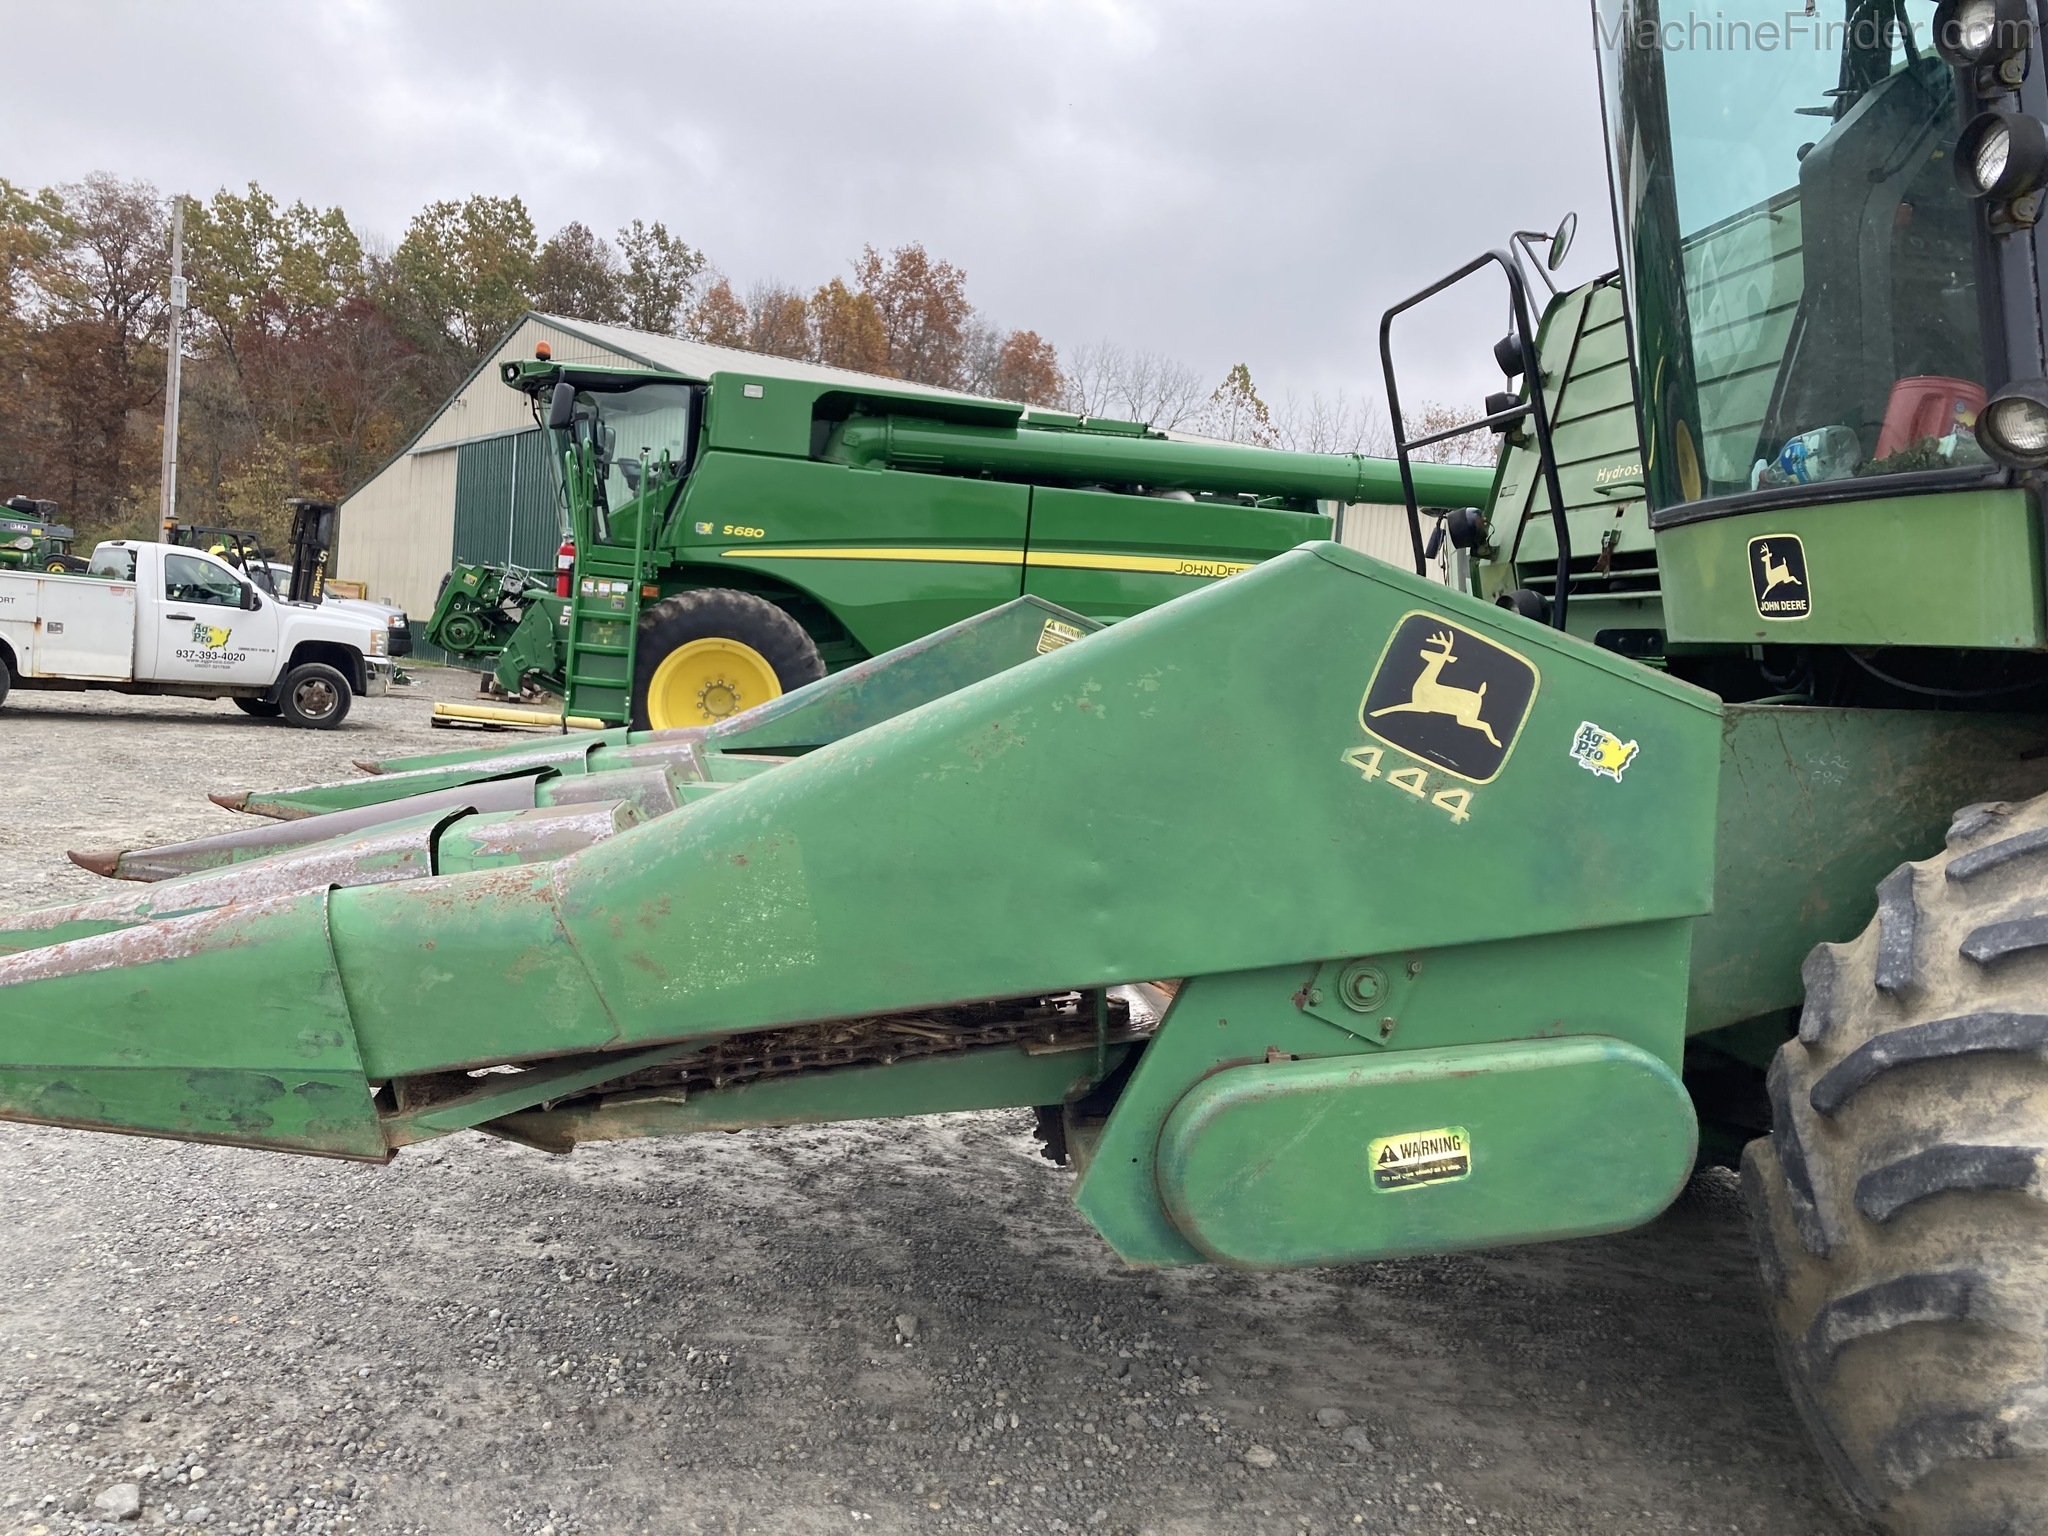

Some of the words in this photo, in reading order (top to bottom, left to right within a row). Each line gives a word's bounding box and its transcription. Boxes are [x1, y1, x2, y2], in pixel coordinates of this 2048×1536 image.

[722, 524, 765, 538] S680
[318, 550, 329, 562] 5
[1175, 561, 1213, 575] JOHN
[1760, 600, 1780, 612] JOHN
[1780, 599, 1807, 611] DEERE
[192, 633, 212, 643] Pro
[175, 649, 246, 662] 937-393-4020
[1574, 739, 1604, 760] Pro
[1340, 744, 1474, 825] 444
[1400, 1135, 1461, 1159] WARNING
